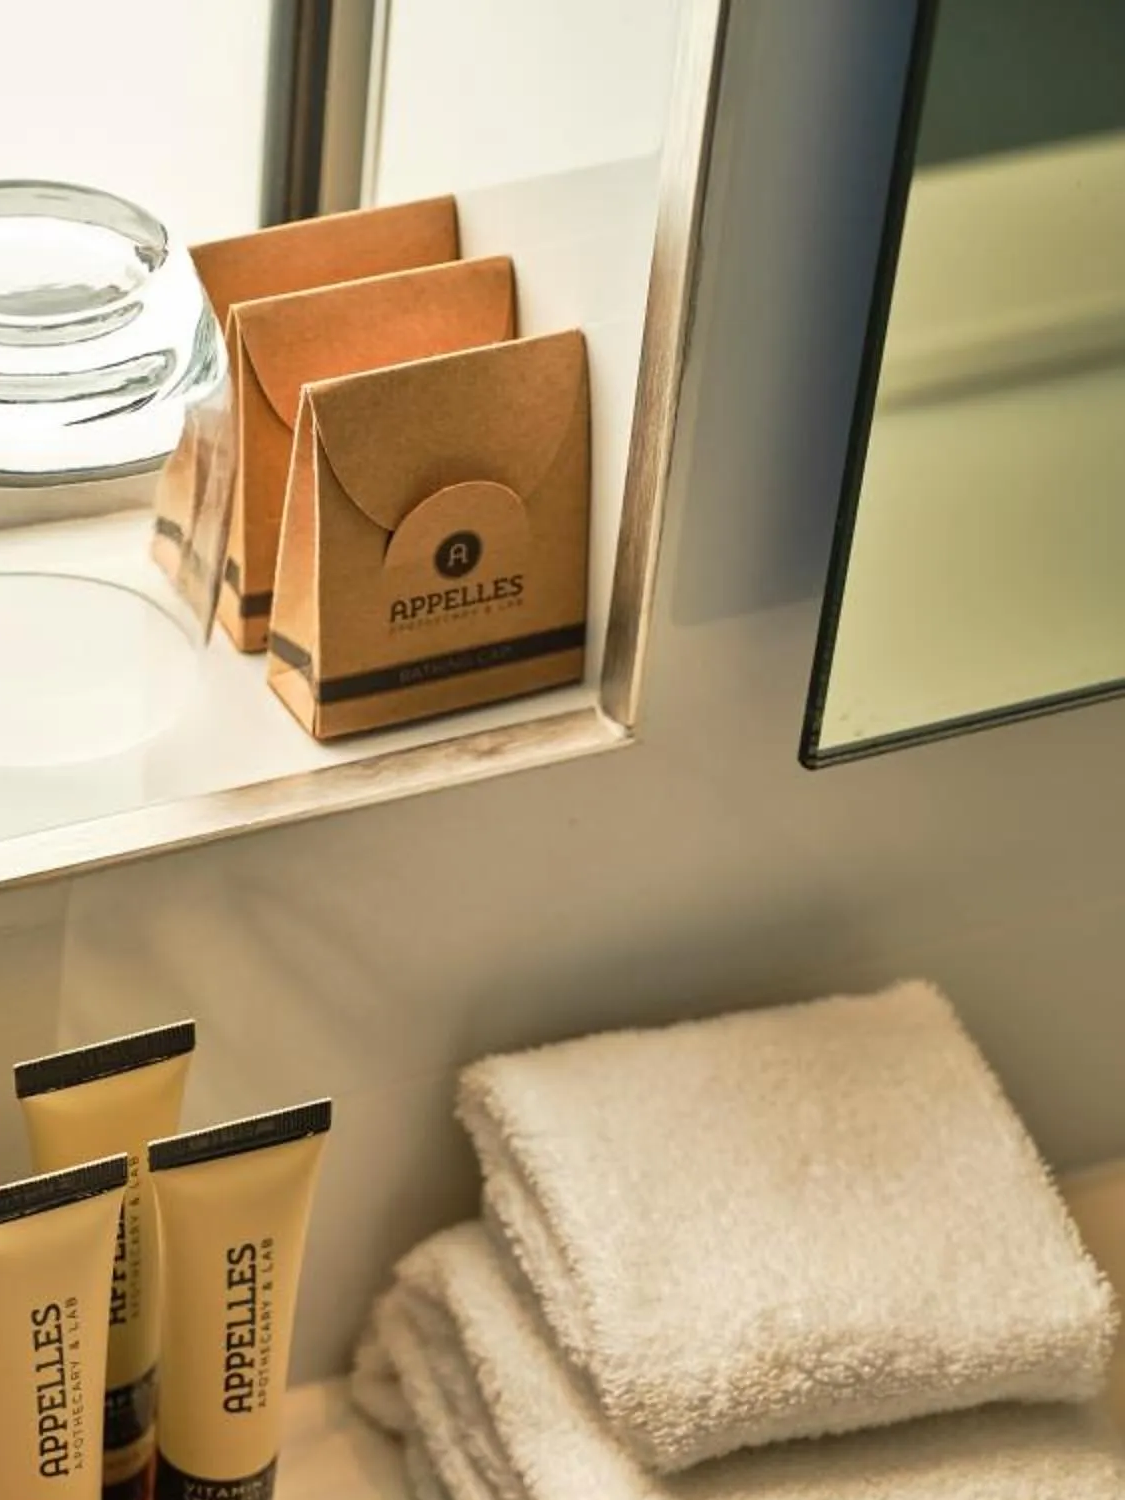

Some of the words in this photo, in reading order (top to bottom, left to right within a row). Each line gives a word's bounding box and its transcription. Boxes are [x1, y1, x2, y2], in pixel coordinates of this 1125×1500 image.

[388, 574, 525, 624] APPELLES
[260, 1236, 275, 1274] LAB
[65, 1296, 80, 1333] LAB
[221, 1242, 257, 1414] APPELLES
[31, 1302, 70, 1479] APPELLES
